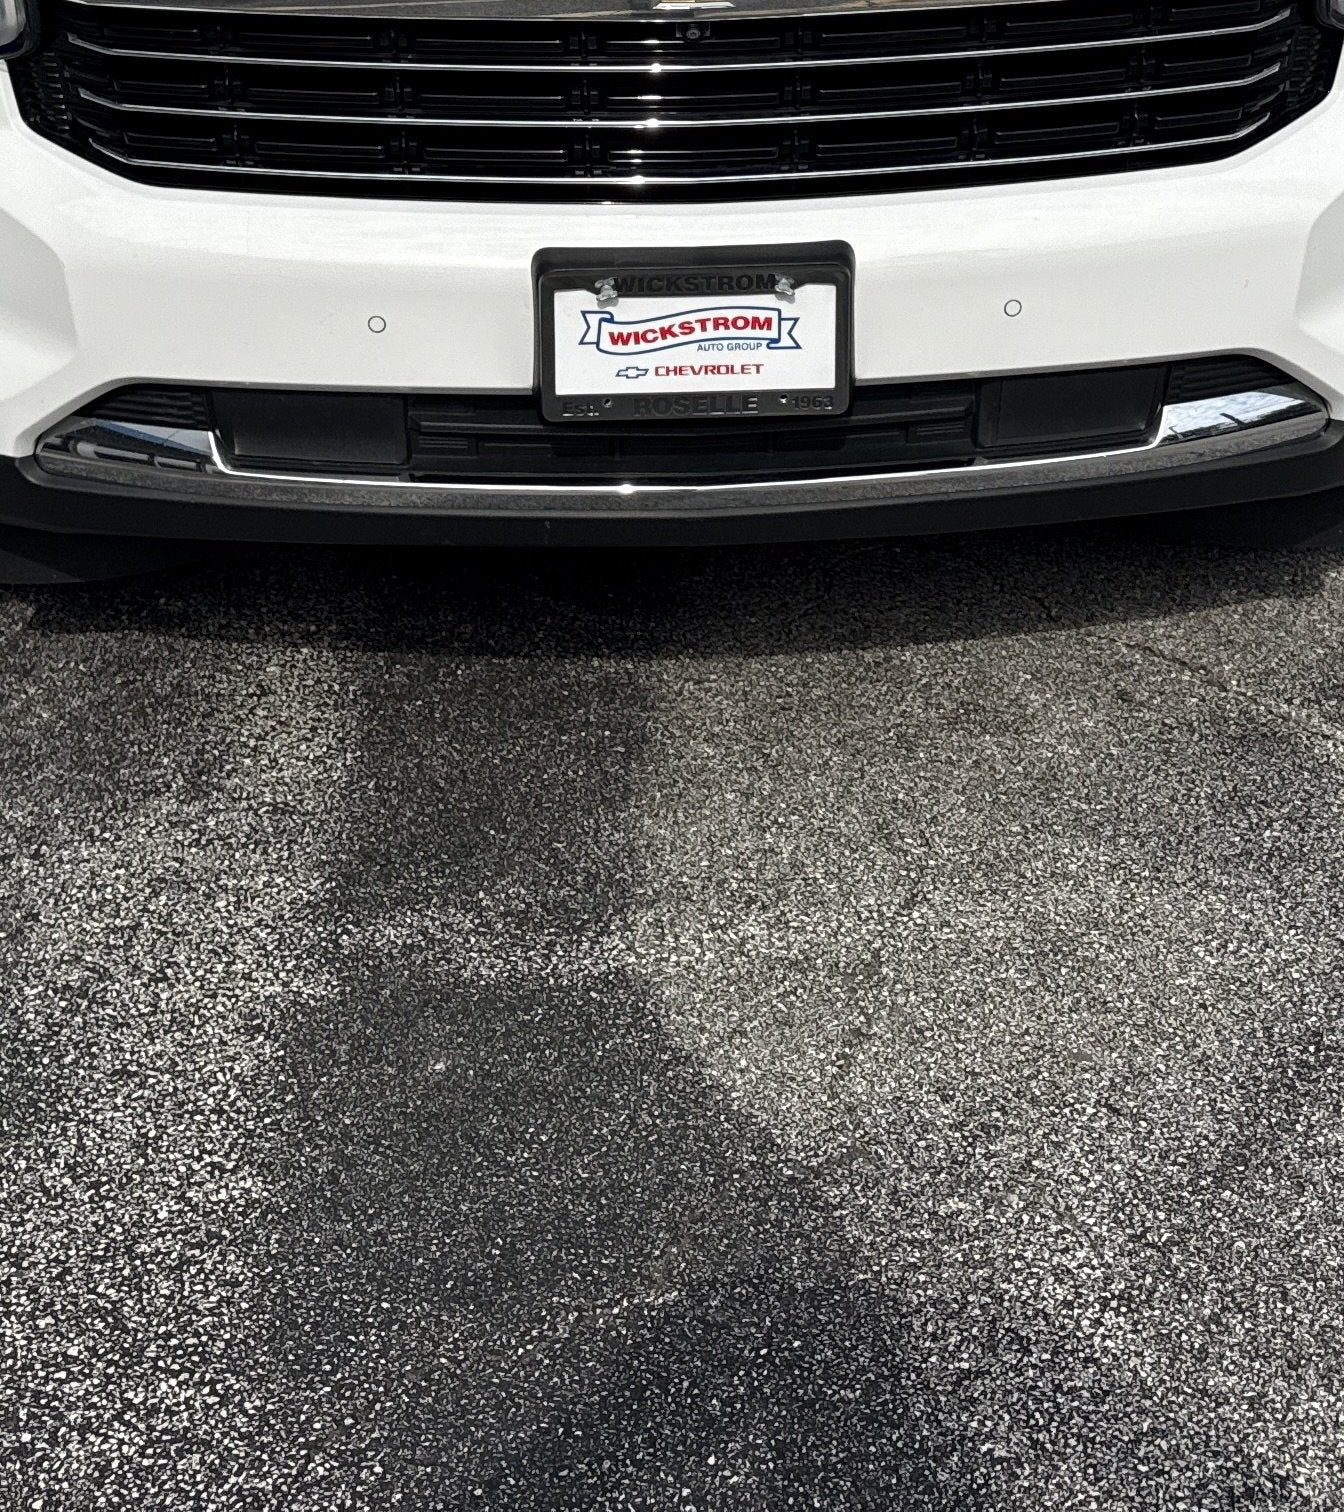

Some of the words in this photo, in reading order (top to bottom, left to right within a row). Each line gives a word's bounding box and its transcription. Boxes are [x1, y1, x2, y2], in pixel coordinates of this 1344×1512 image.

[613, 273, 776, 294] WICKSTROM
[608, 316, 773, 346] WICKSTROM
[696, 342, 725, 352] AUTO
[727, 341, 763, 352] GROUP
[654, 363, 765, 377] CHEVROLET
[633, 394, 758, 417] ROSELLE
[791, 394, 834, 410] 1963
